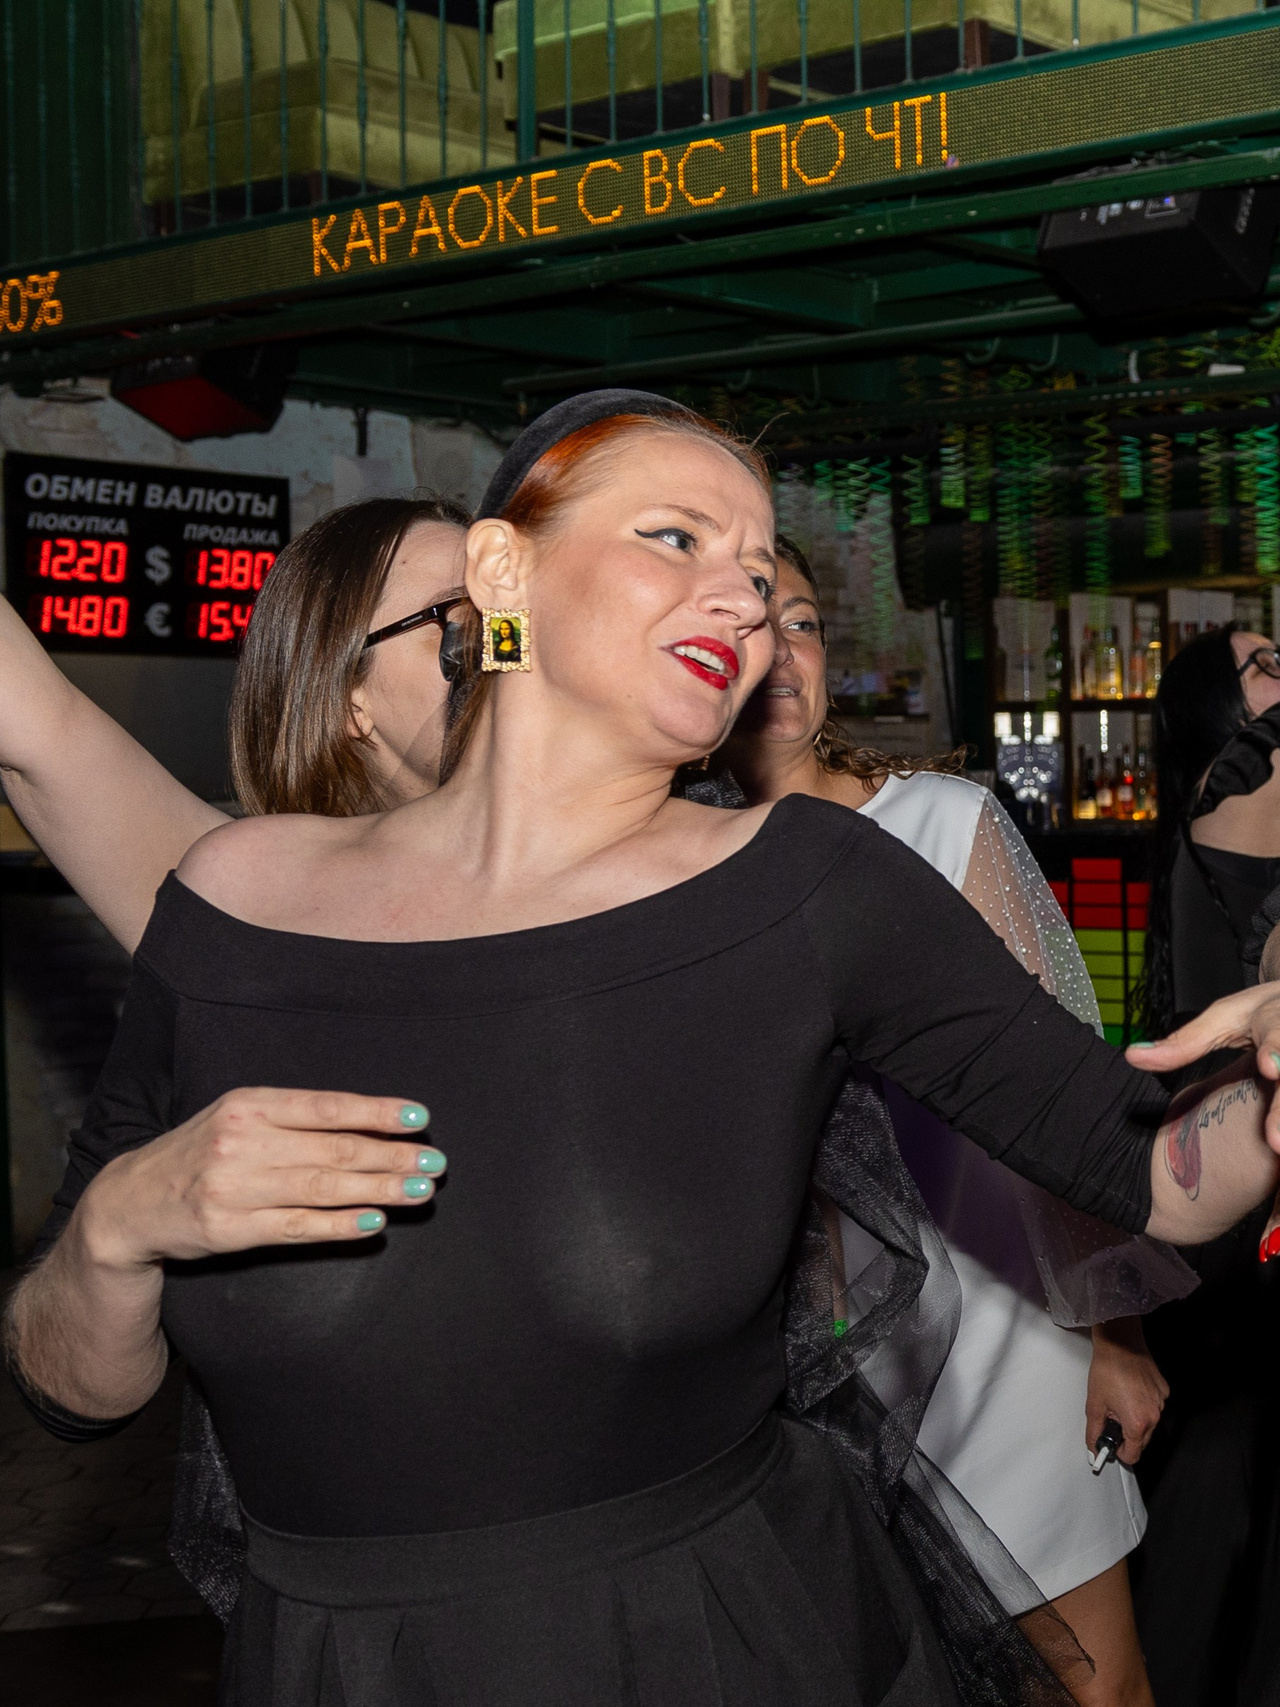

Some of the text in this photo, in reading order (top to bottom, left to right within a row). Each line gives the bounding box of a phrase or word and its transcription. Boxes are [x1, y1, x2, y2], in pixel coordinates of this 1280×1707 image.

[0, 270, 64, 333] 0%
[312, 169, 560, 276] КАРАОКЕ
[577, 158, 624, 226] С
[643, 138, 727, 215] ВС
[751, 115, 845, 195] ПО
[864, 92, 949, 169] ЧТ!
[25, 473, 278, 518] ОБМЕН ВАЛЮТЫ
[27, 511, 280, 546] ПОКУПКА ПРОДАЖА
[145, 546, 172, 585] $
[144, 602, 172, 637] €
